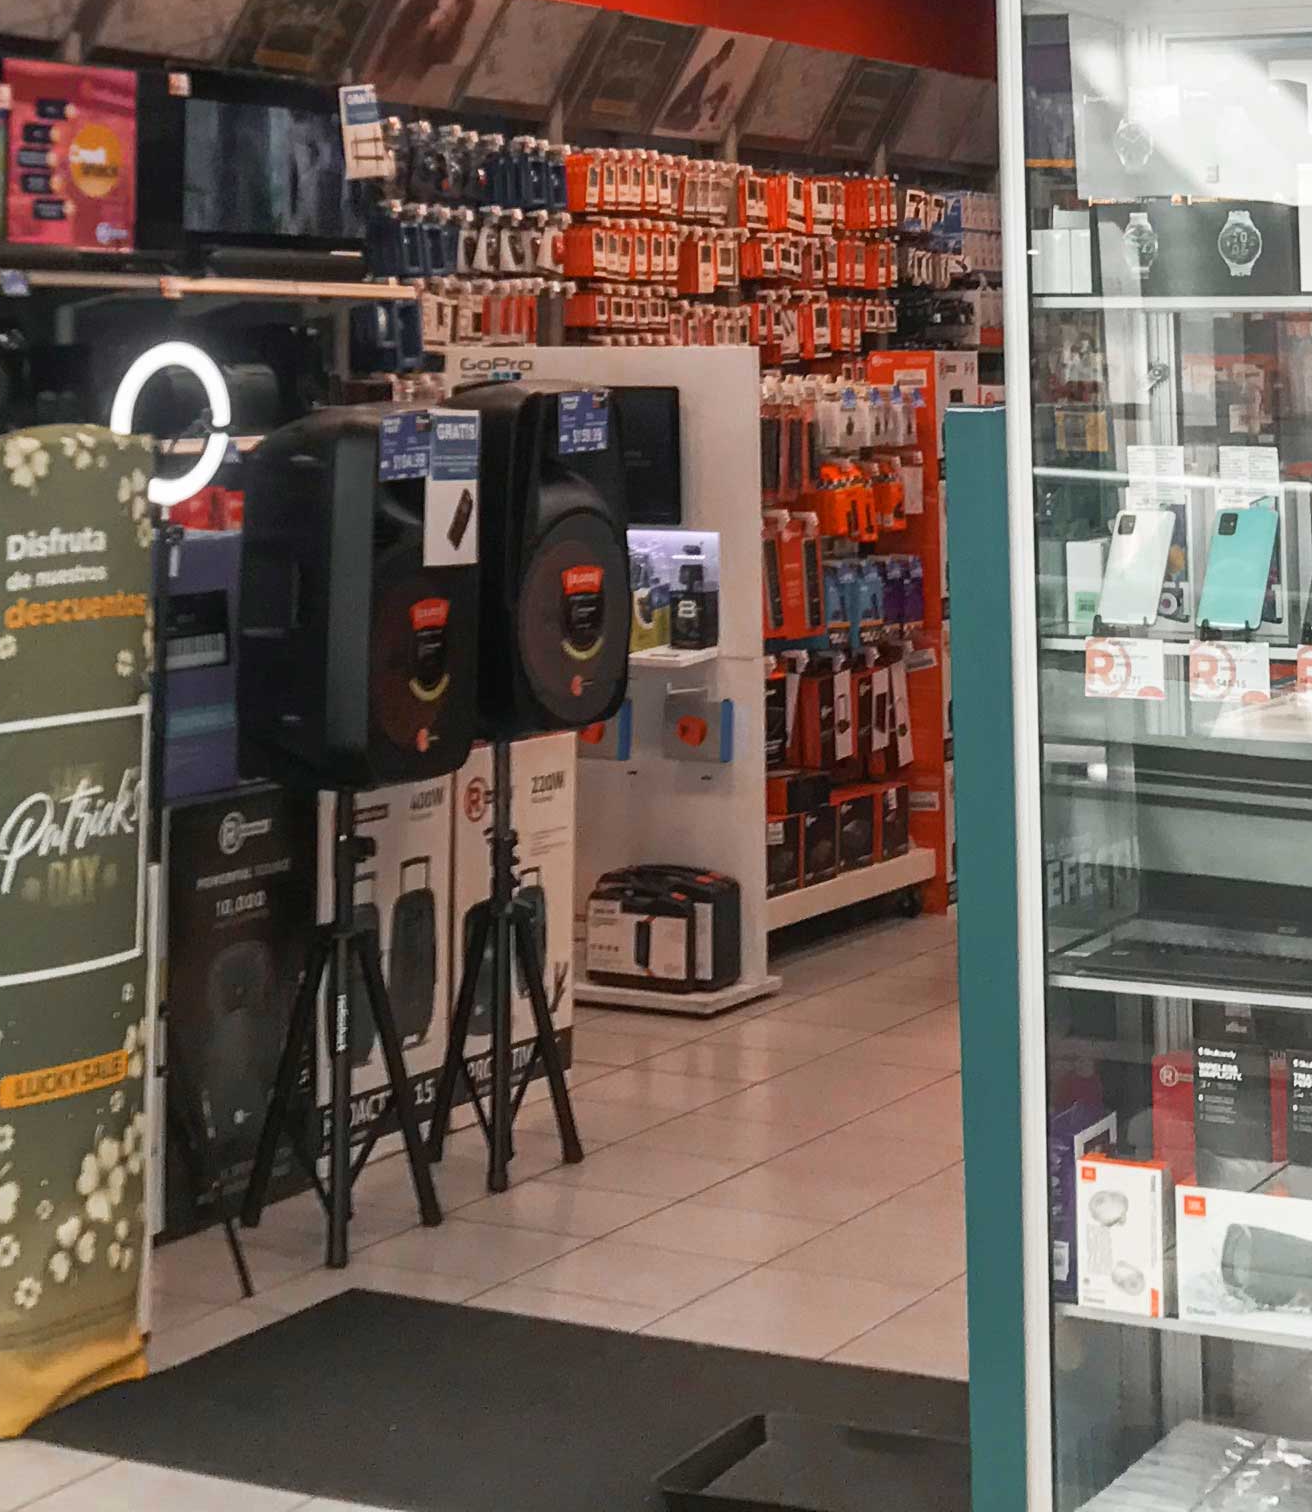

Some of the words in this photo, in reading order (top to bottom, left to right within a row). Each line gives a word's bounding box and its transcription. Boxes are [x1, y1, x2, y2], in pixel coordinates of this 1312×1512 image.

[459, 357, 534, 372] GoPro
[5, 526, 108, 562] Disfruta
[5, 569, 33, 592] de
[529, 769, 567, 795] 220W
